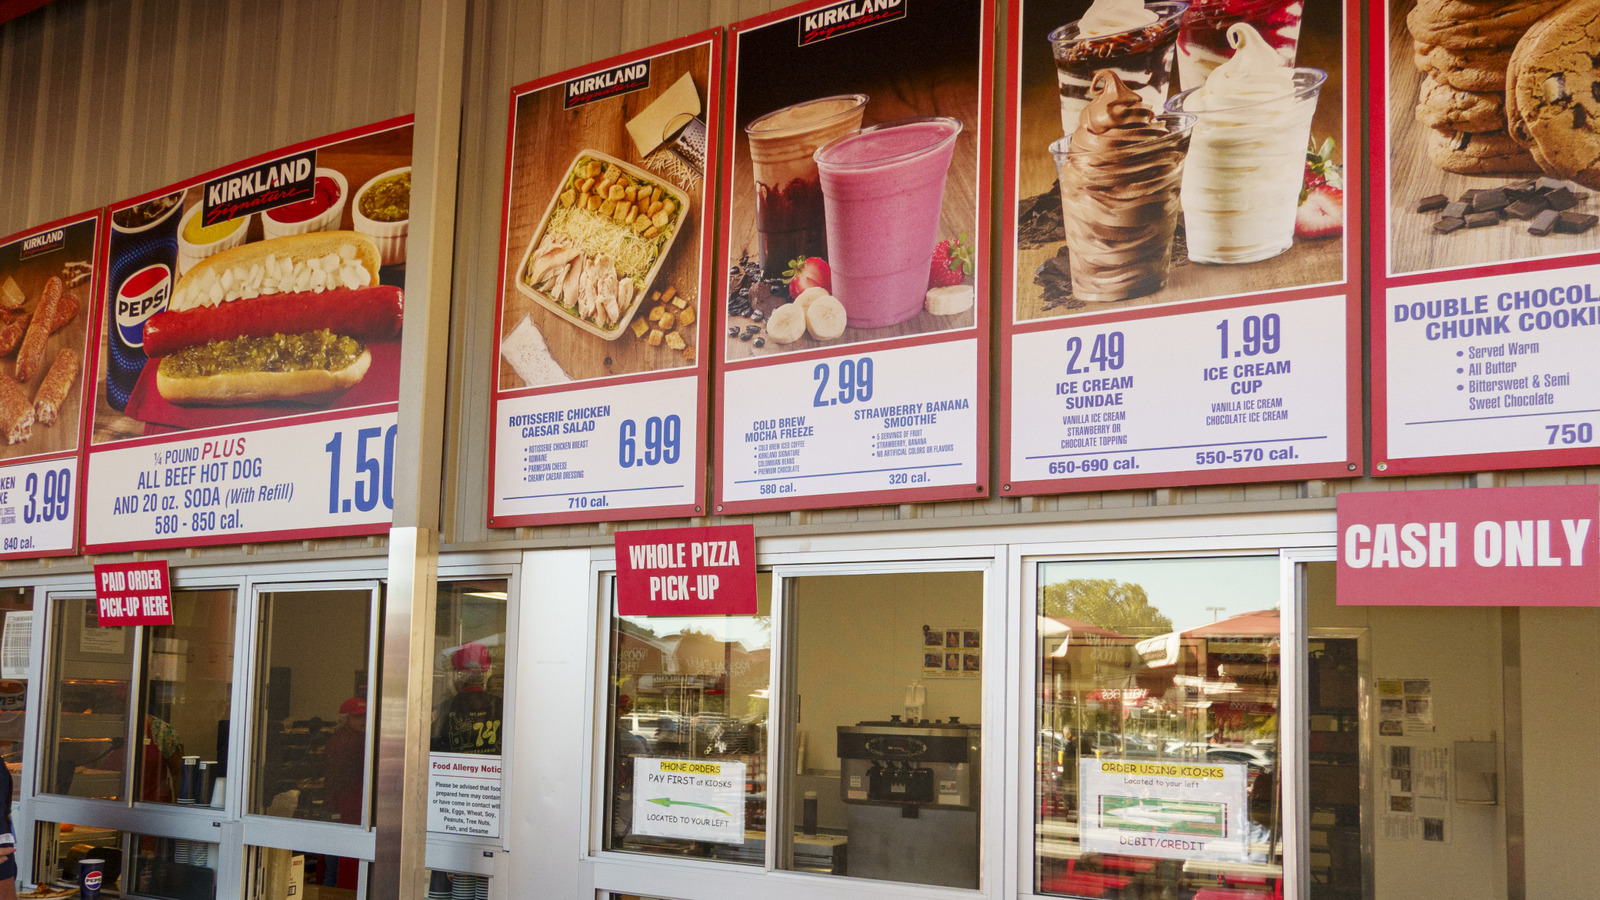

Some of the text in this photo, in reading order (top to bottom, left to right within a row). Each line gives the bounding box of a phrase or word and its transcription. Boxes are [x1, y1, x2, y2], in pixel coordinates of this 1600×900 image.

[805, 0, 901, 32] KIRKLAND
[804, 10, 902, 44] Signature
[569, 64, 647, 97] KIRKLAND
[568, 81, 646, 107] Signature
[208, 157, 311, 207] KIRKLAND
[207, 188, 310, 225] Signature
[23, 230, 64, 251] KIRKLAND
[118, 283, 169, 317] PEPSI
[1394, 283, 1600, 322] DOUBLE CHOCOL
[1425, 305, 1600, 341] CHUNK COOKI
[1216, 313, 1281, 359] 1.99
[1066, 331, 1125, 375] 2.49
[1468, 342, 1540, 359] Served Warm
[1203, 360, 1291, 381] ICE CREAM
[1468, 361, 1517, 376] All Butter
[813, 357, 874, 408] 2.99
[1056, 375, 1133, 395] ICE CREAM
[1231, 379, 1263, 395] CUP
[1469, 372, 1570, 393] Bittersweet & Semi
[854, 398, 969, 420] STRAWBERRY BANANA
[1065, 392, 1123, 410] SUNDAE
[1211, 397, 1283, 413] VANILLA ICE CREAM
[1469, 392, 1554, 411] Sweet Chocolate
[509, 405, 610, 427] ROTISSERIE CHICKEN
[753, 416, 805, 431] COLD BREW
[884, 413, 937, 428] SMOOTHIE
[1063, 411, 1126, 425] VANILLA ICE CREAM
[1206, 410, 1288, 426] CHOCOLATE ICE CREAM
[521, 420, 595, 438] CAESAR SALAD
[745, 426, 814, 442] MOCHA FREEZE
[1067, 423, 1121, 436] STRAWBERRY OR
[1545, 422, 1593, 445] 750
[528, 440, 588, 453] ROTISSERIE CHICKEN BREAST
[619, 414, 681, 468] 6.99
[1061, 435, 1127, 449] CHOCOLATE TOPPING
[165, 447, 199, 464] POUND
[201, 437, 246, 460] PLUS
[528, 453, 547, 463] ROMAINE
[1195, 445, 1299, 465] 550-570 cal.
[137, 457, 262, 490] ALL BEEF HOT DOG
[528, 461, 567, 472] PARMESAN CHEESE
[1048, 456, 1140, 474] 650-690 cal.
[528, 470, 584, 482] CREAMY CAESAR DRESSING
[889, 471, 931, 485] 320 cal.
[24, 468, 71, 524] 3.99
[760, 482, 797, 495] 580 cal.
[113, 482, 294, 515] AND 20 oz. SODA (With Refill)
[568, 495, 609, 509] 710 cal.
[155, 514, 178, 535] 580
[191, 511, 216, 531] 850
[220, 509, 243, 530] cal.
[4, 535, 35, 550] 840 cal.
[1344, 518, 1592, 569] CASH ONLY
[629, 540, 740, 569] WHOLE PIZZA
[101, 569, 162, 592] PAID ORDER
[649, 574, 719, 601] PICK-UP
[99, 595, 169, 618] PICK-UP HERE
[432, 762, 451, 770] Food
[453, 763, 479, 773] Allergy
[660, 761, 721, 774] PHONE ORDERS
[1101, 762, 1224, 778] ORDER USING KIOSKS
[648, 773, 665, 783] PAY
[667, 775, 695, 786] FIRST
[704, 779, 732, 788] KIOSKS
[1123, 777, 1153, 786] Located
[1184, 780, 1199, 788] left
[435, 790, 458, 798] prepared
[443, 816, 465, 824] Peanuts,
[478, 819, 491, 827] Nuts,
[451, 808, 465, 816] Eggs,
[467, 809, 484, 817] Wheat,
[485, 811, 497, 819] Soy,
[647, 813, 729, 828] LOCATED TO YOUR LEFT
[445, 824, 458, 832] Fish,
[1119, 835, 1205, 851] DEBIT/CREDIT
